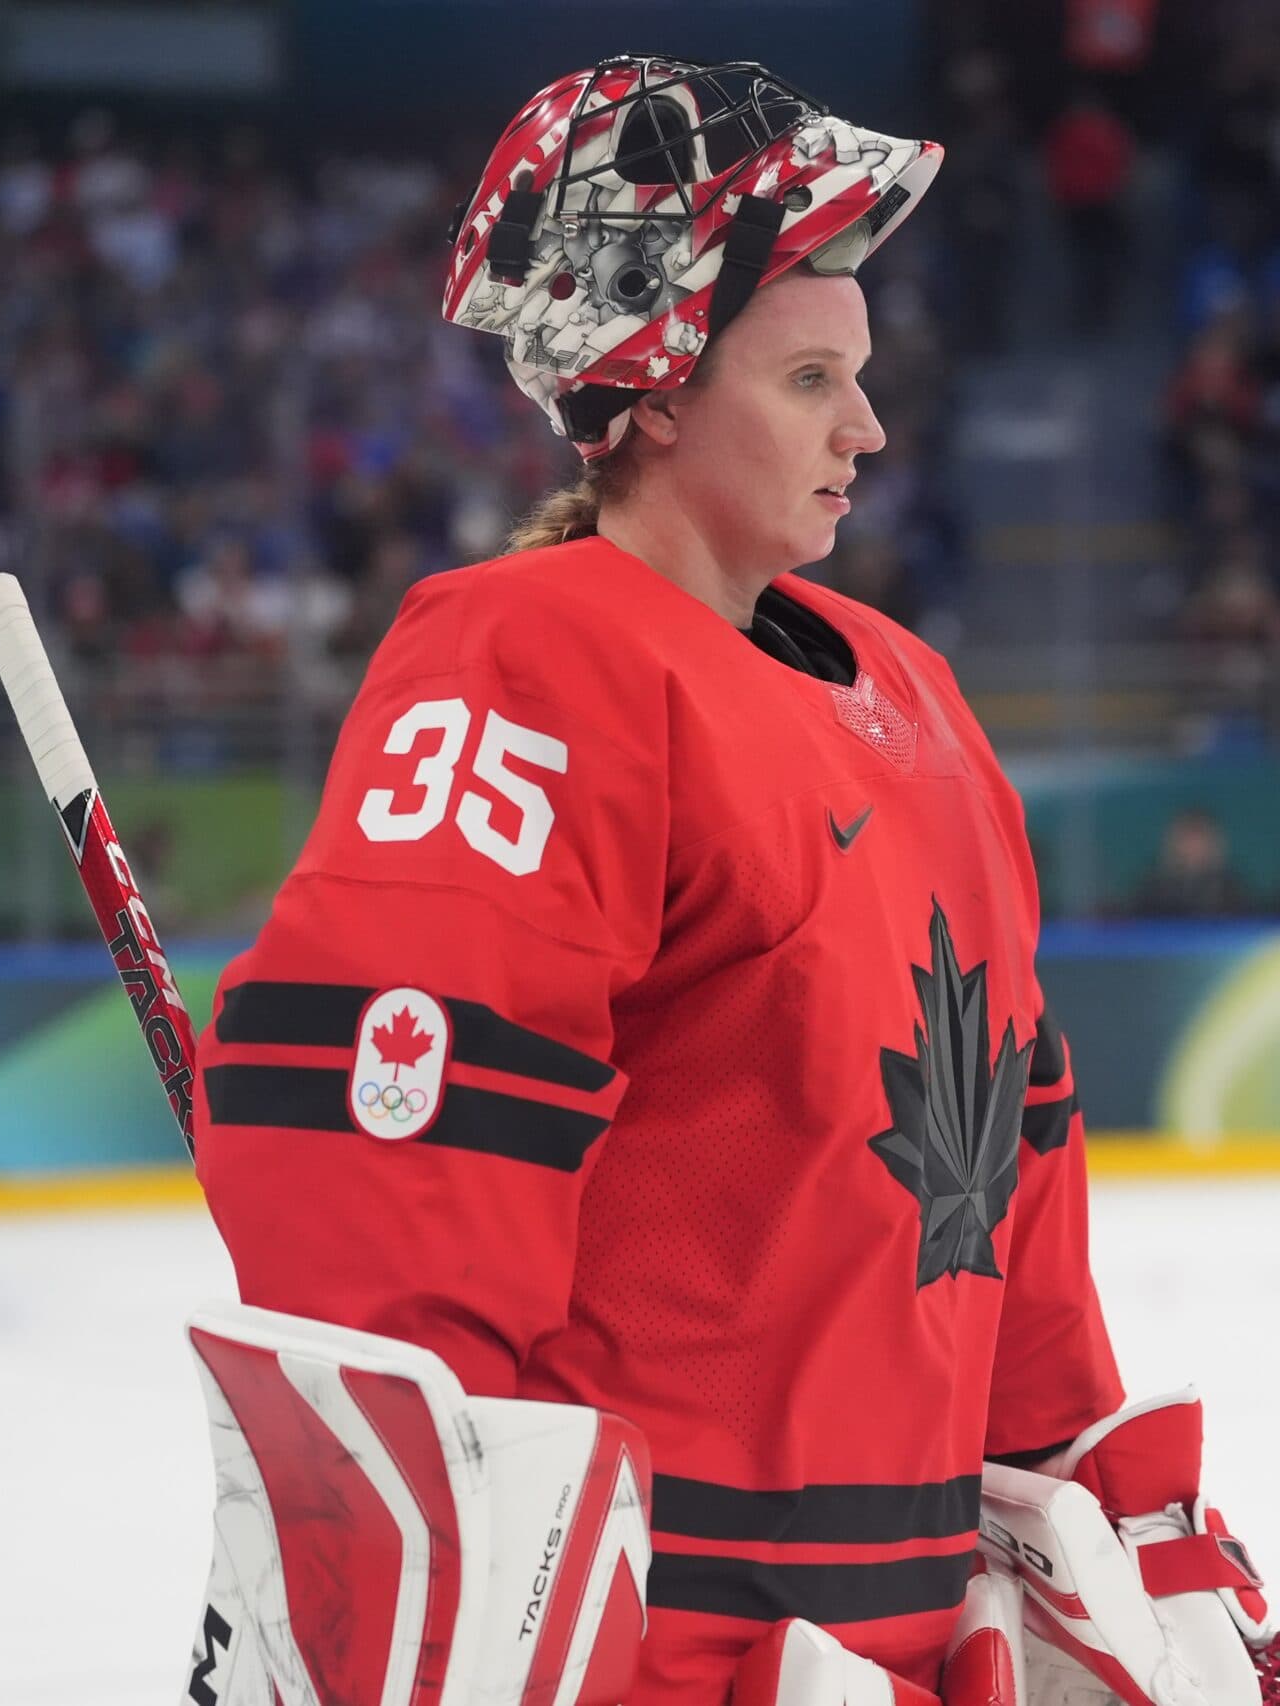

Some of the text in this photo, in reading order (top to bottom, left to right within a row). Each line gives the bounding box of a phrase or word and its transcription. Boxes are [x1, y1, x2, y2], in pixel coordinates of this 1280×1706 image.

[357, 697, 568, 877] 35
[105, 840, 186, 1012] CCM
[107, 908, 197, 1168] TACK
[518, 1527, 562, 1641] TACKS
